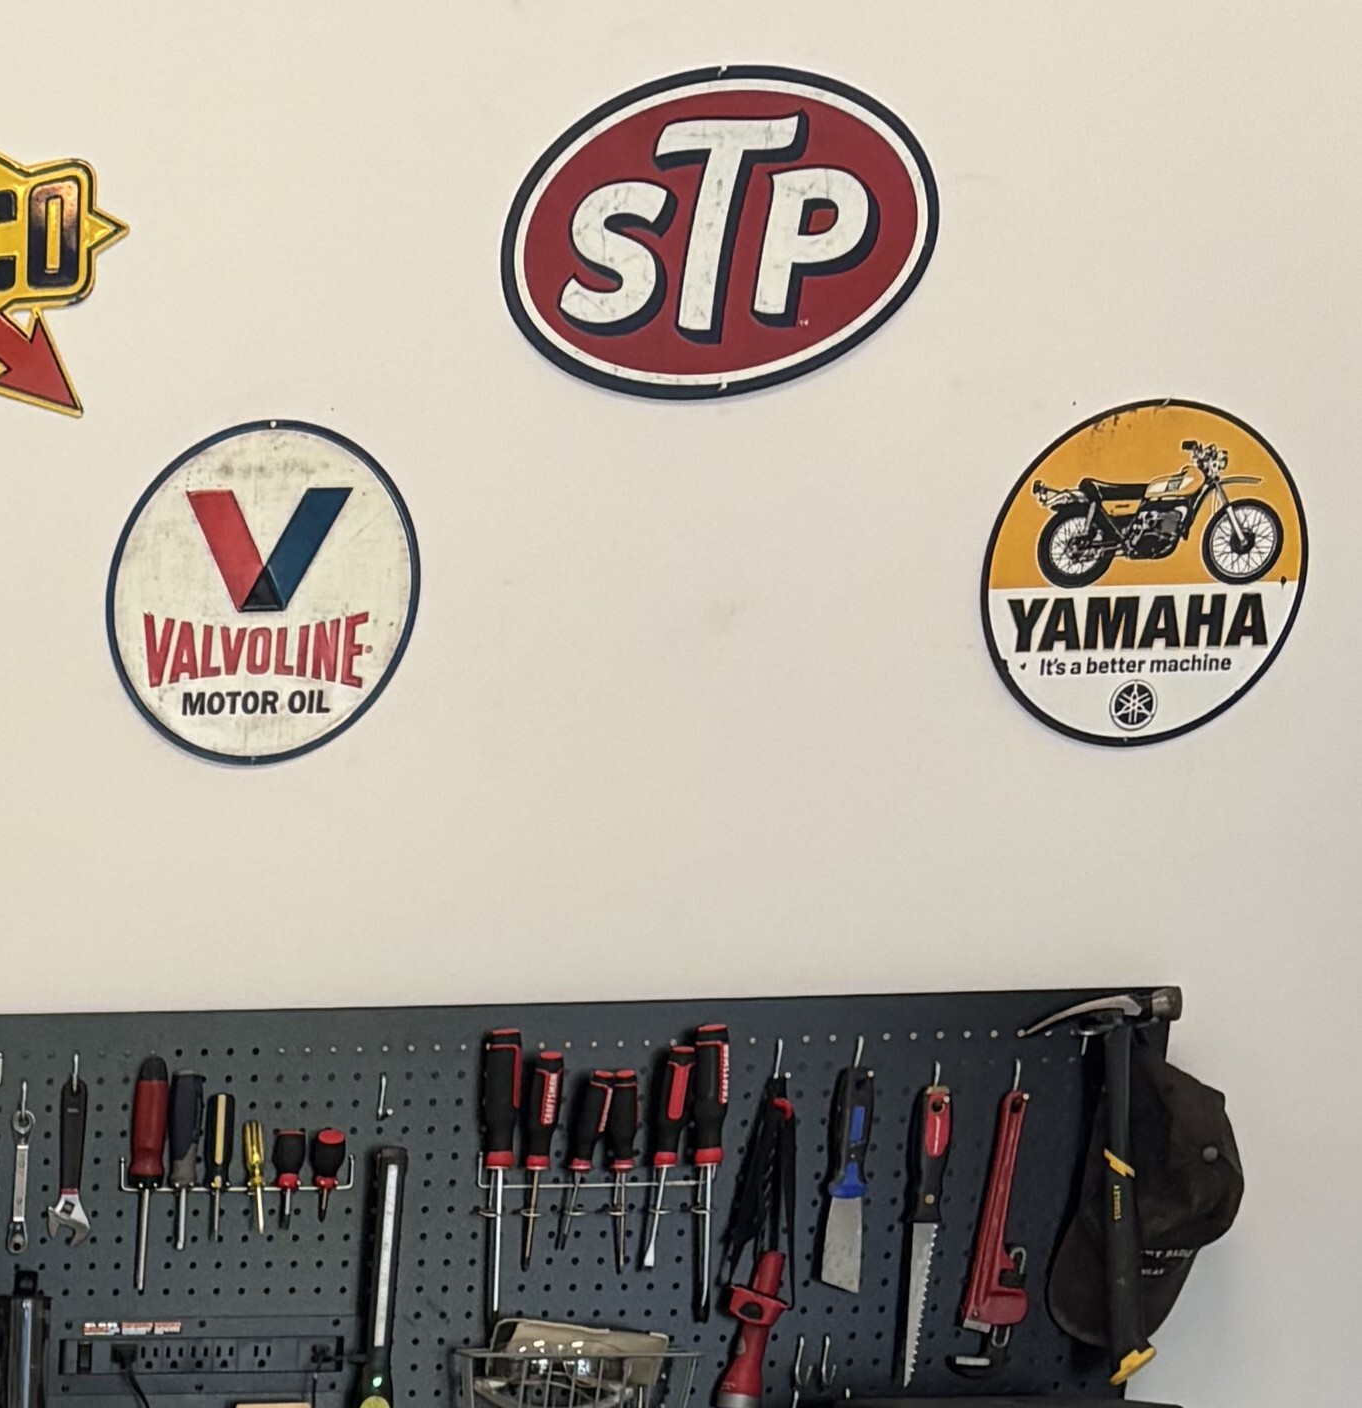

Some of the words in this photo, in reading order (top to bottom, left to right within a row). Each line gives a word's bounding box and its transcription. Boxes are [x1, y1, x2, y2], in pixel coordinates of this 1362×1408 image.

[558, 108, 880, 345] STP
[143, 611, 369, 689] VALVOLINE
[1007, 592, 1268, 653] YAMAHA
[1039, 657, 1066, 676] It's
[1070, 661, 1082, 675] a
[1086, 656, 1146, 675] better
[1150, 653, 1232, 674] machine
[181, 690, 278, 716] MOTOR
[287, 689, 331, 714] OIL
